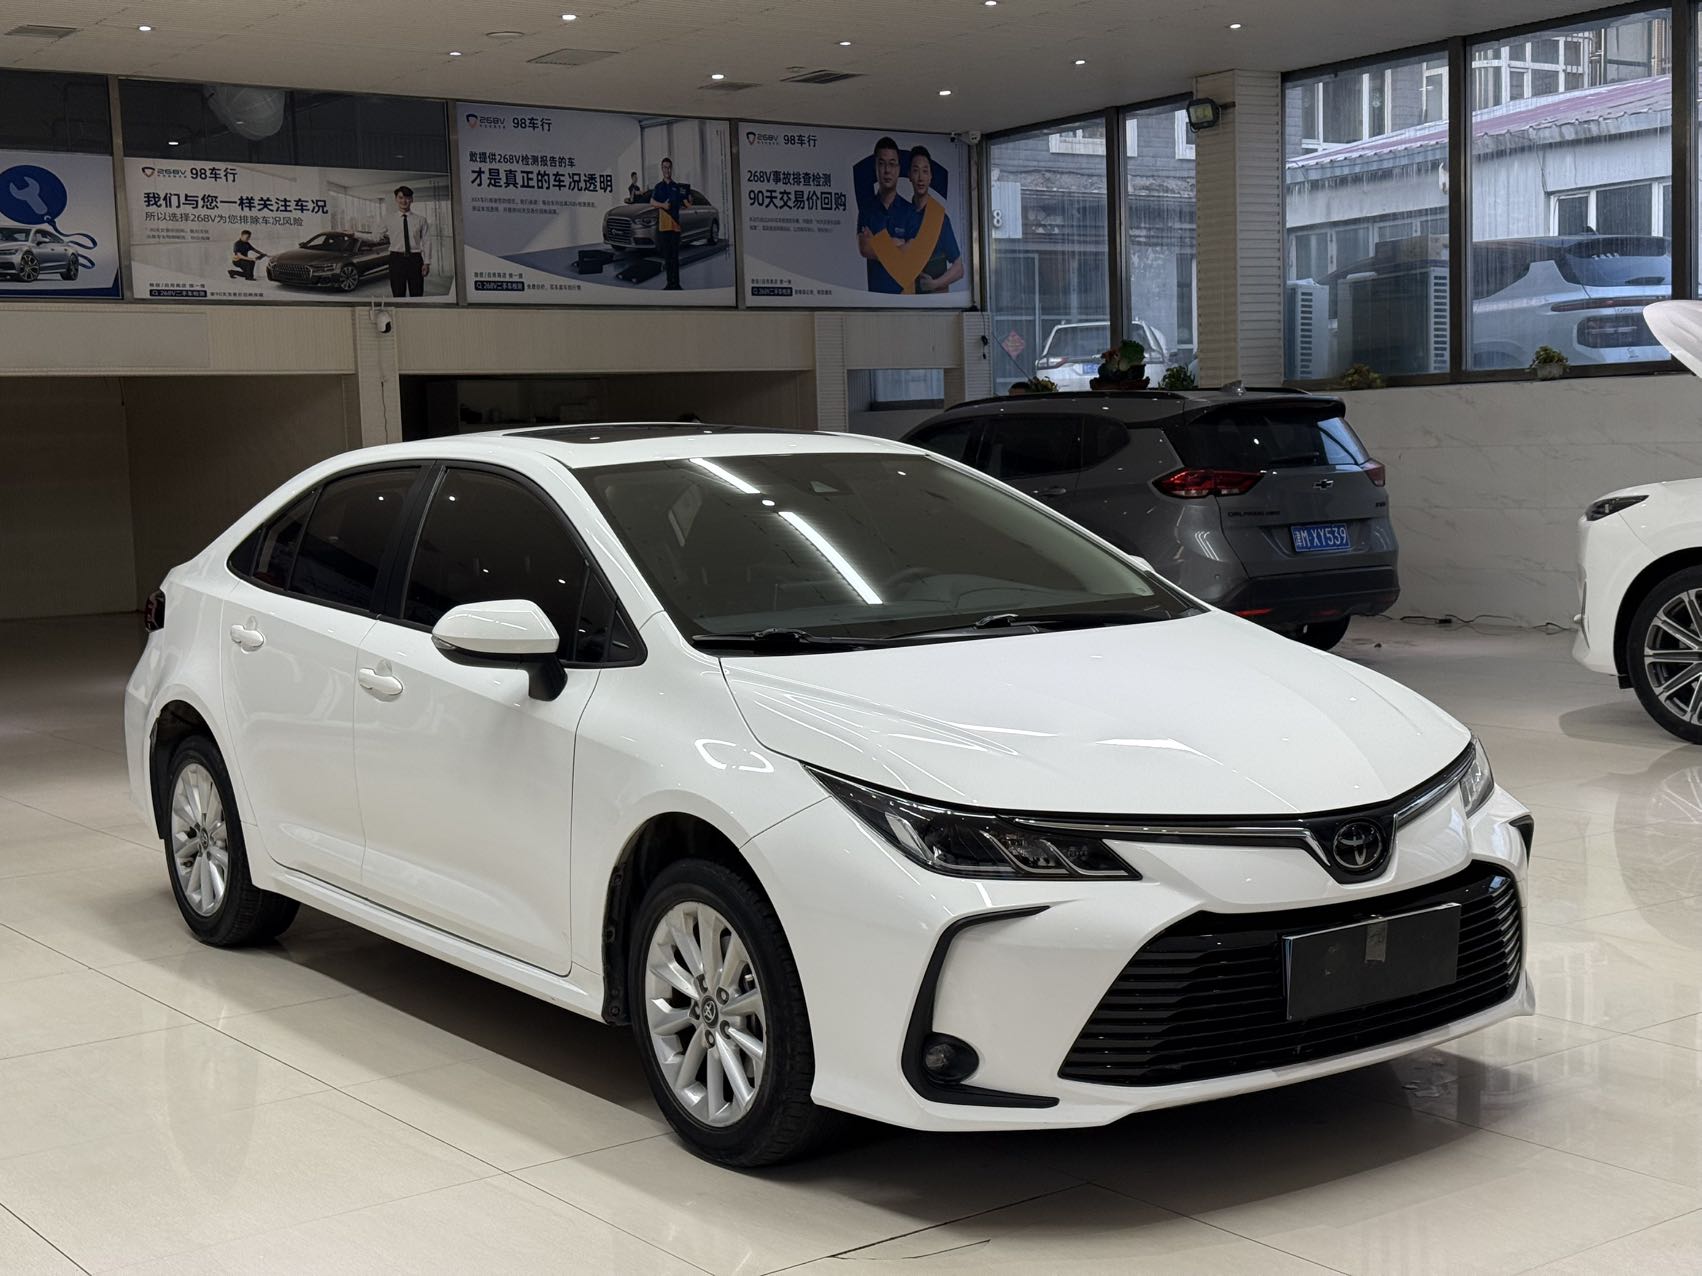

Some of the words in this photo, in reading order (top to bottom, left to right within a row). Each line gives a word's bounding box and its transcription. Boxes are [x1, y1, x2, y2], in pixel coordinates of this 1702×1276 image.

[479, 116, 506, 125] 268V
[512, 116, 553, 132] 98车行
[783, 134, 818, 148] 98车行
[469, 151, 577, 169] 敢提供268V检测报告的车
[190, 166, 238, 183] 98车行
[470, 167, 614, 194] 才是真正的车况透明
[746, 169, 832, 188] 268V事故排查检测
[143, 192, 329, 215] 我们与您一样关注车况
[748, 188, 847, 212] 90天交易价回购
[144, 211, 304, 227] 所以选择268V为您排除车况风险
